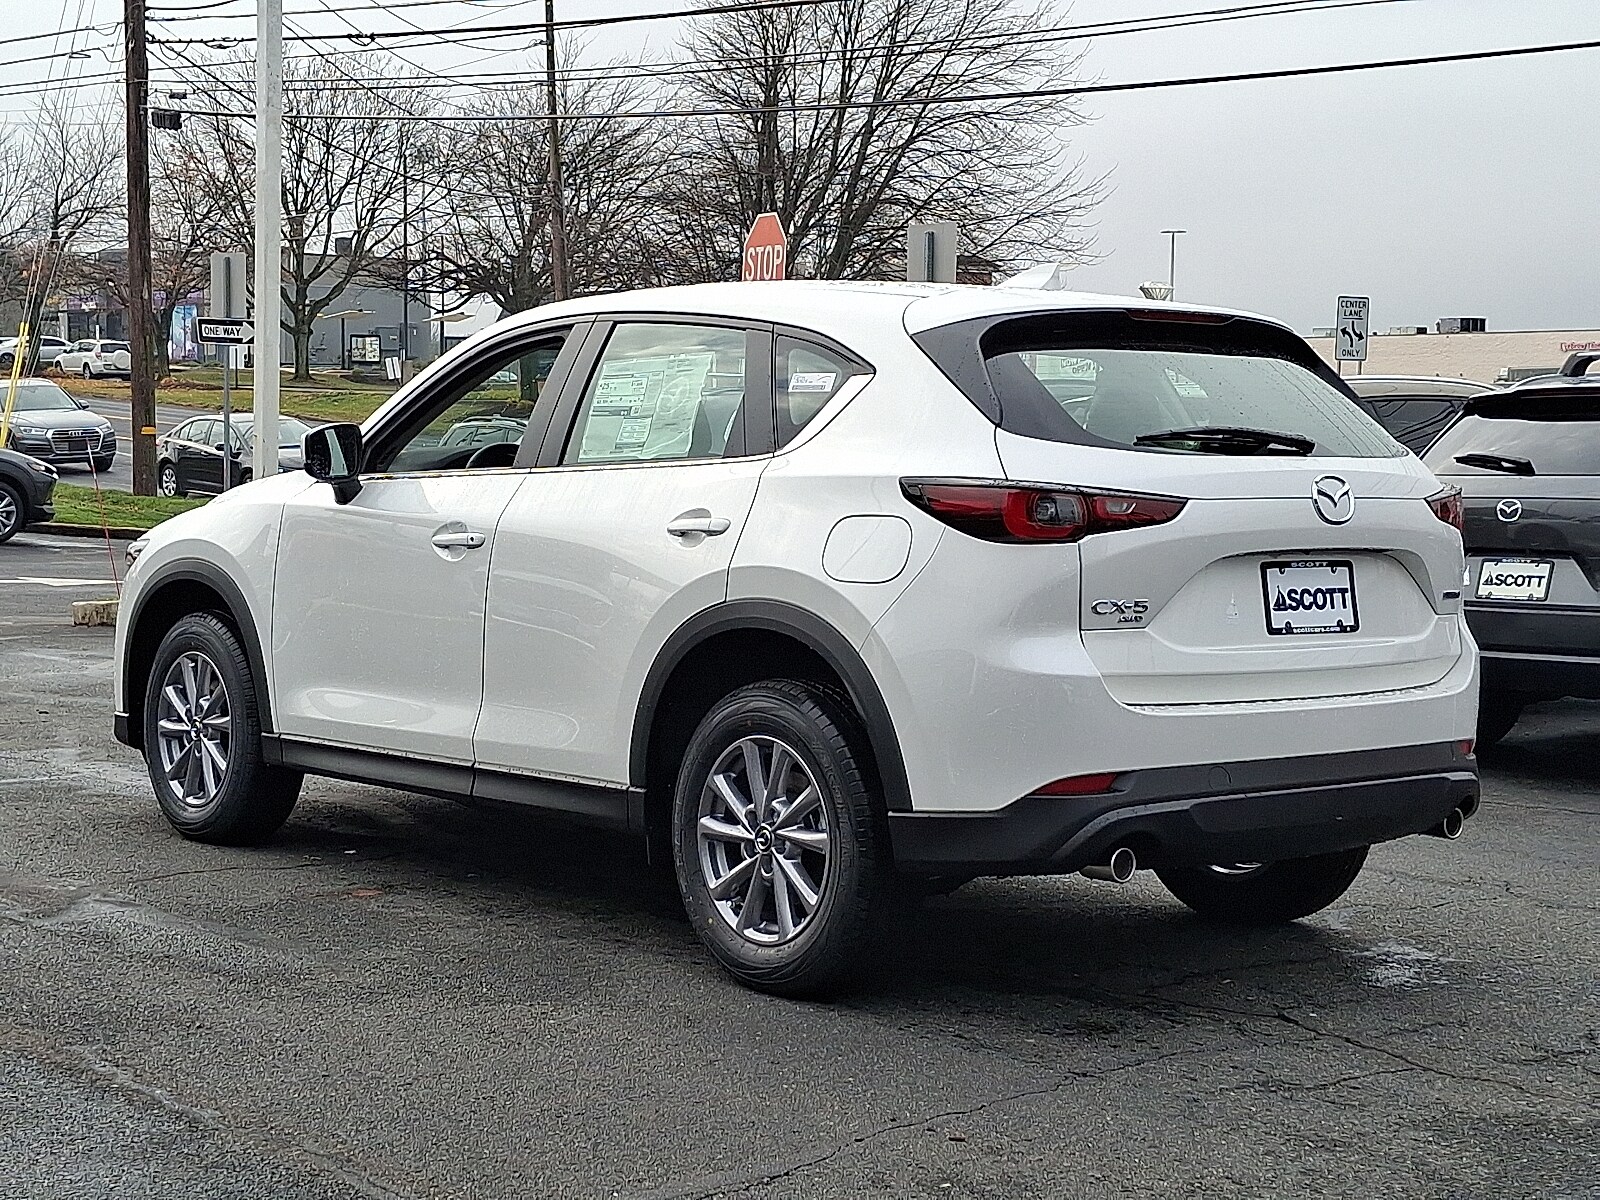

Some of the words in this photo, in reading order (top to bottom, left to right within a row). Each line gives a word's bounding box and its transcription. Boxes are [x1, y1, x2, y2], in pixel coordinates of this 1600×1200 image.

[745, 244, 782, 280] STOP
[1341, 300, 1366, 308] CENTER
[1343, 309, 1362, 317] LANE
[204, 326, 220, 335] ONE
[222, 327, 241, 336] WAY
[1342, 349, 1360, 357] ONLY
[1494, 574, 1546, 588] SCOTT
[1286, 587, 1349, 611] SCOTT
[1091, 598, 1149, 615] CX-5
